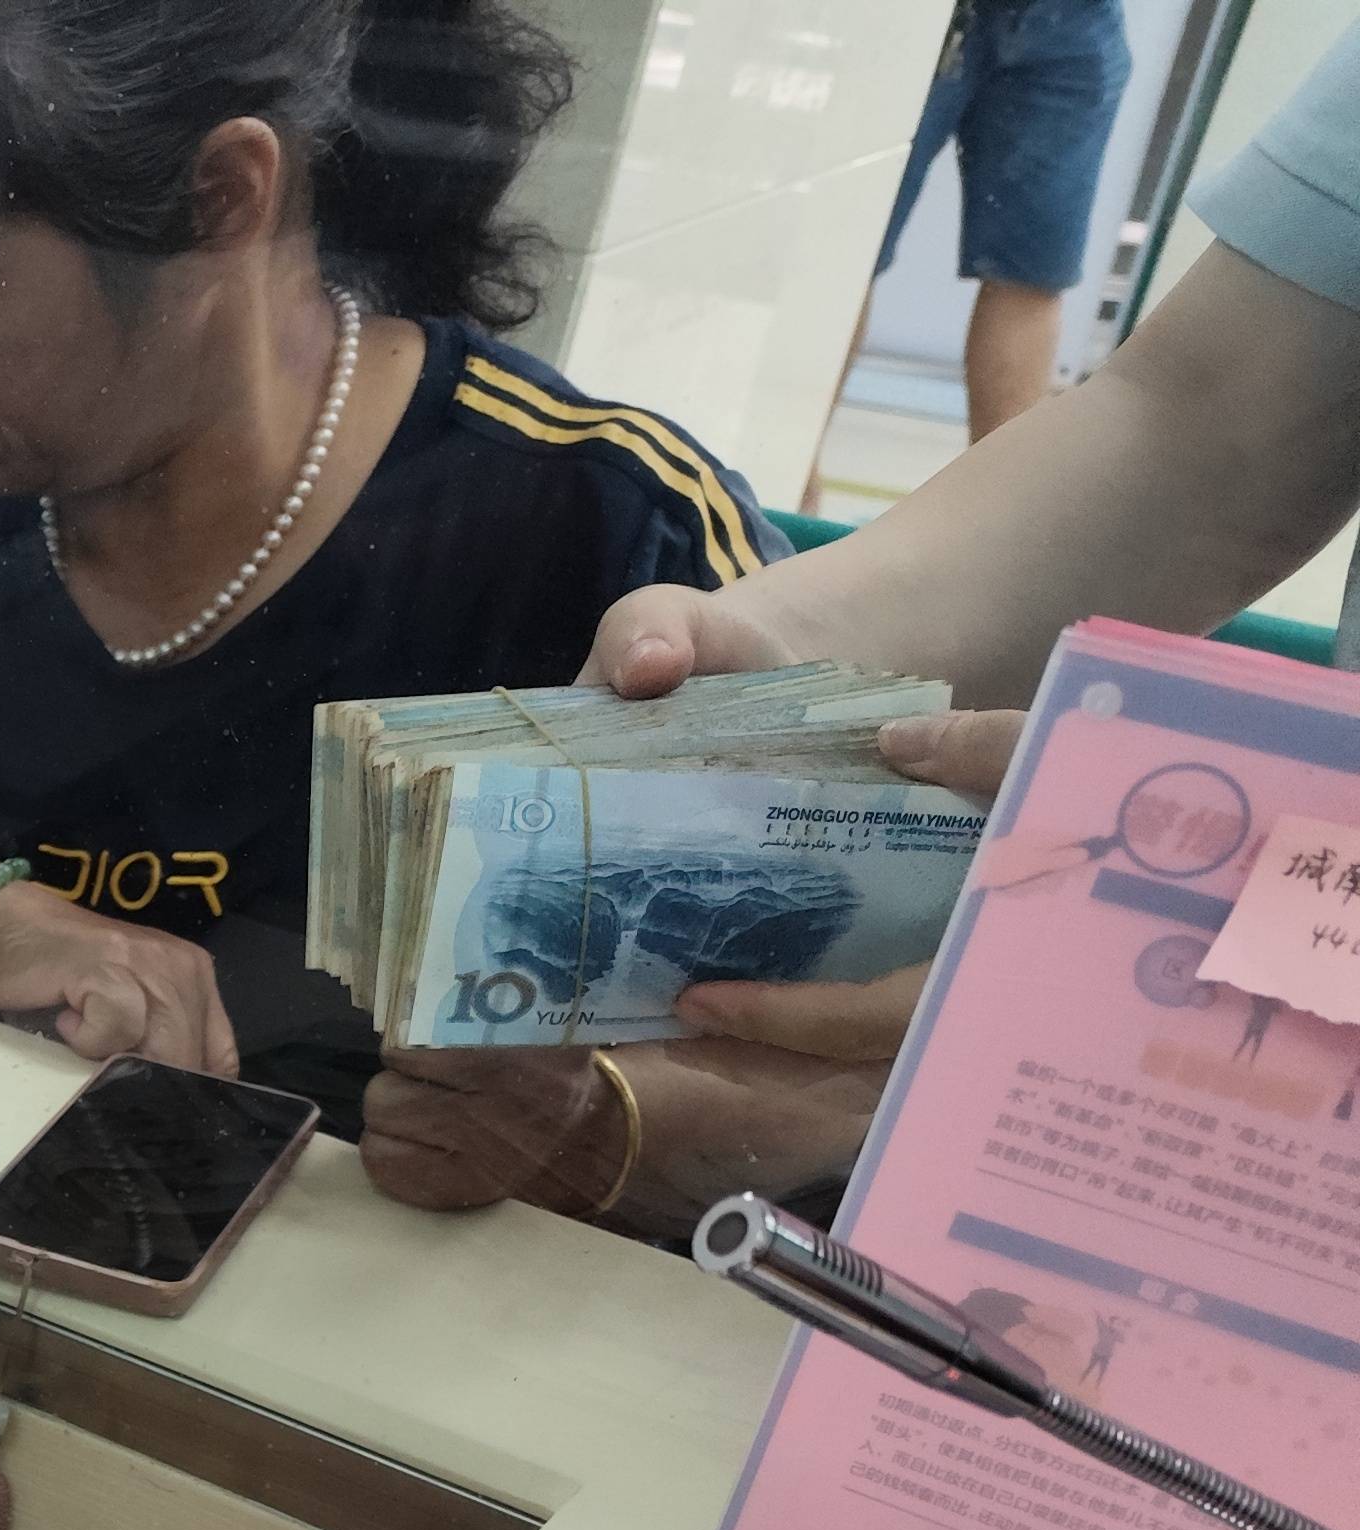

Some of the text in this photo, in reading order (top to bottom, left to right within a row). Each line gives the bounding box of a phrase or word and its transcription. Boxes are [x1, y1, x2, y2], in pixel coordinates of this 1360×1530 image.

[495, 794, 557, 834] 10
[765, 806, 924, 829] ZHONGGUO RENMIN
[35, 841, 230, 917] DIOR
[446, 969, 541, 1027] 10
